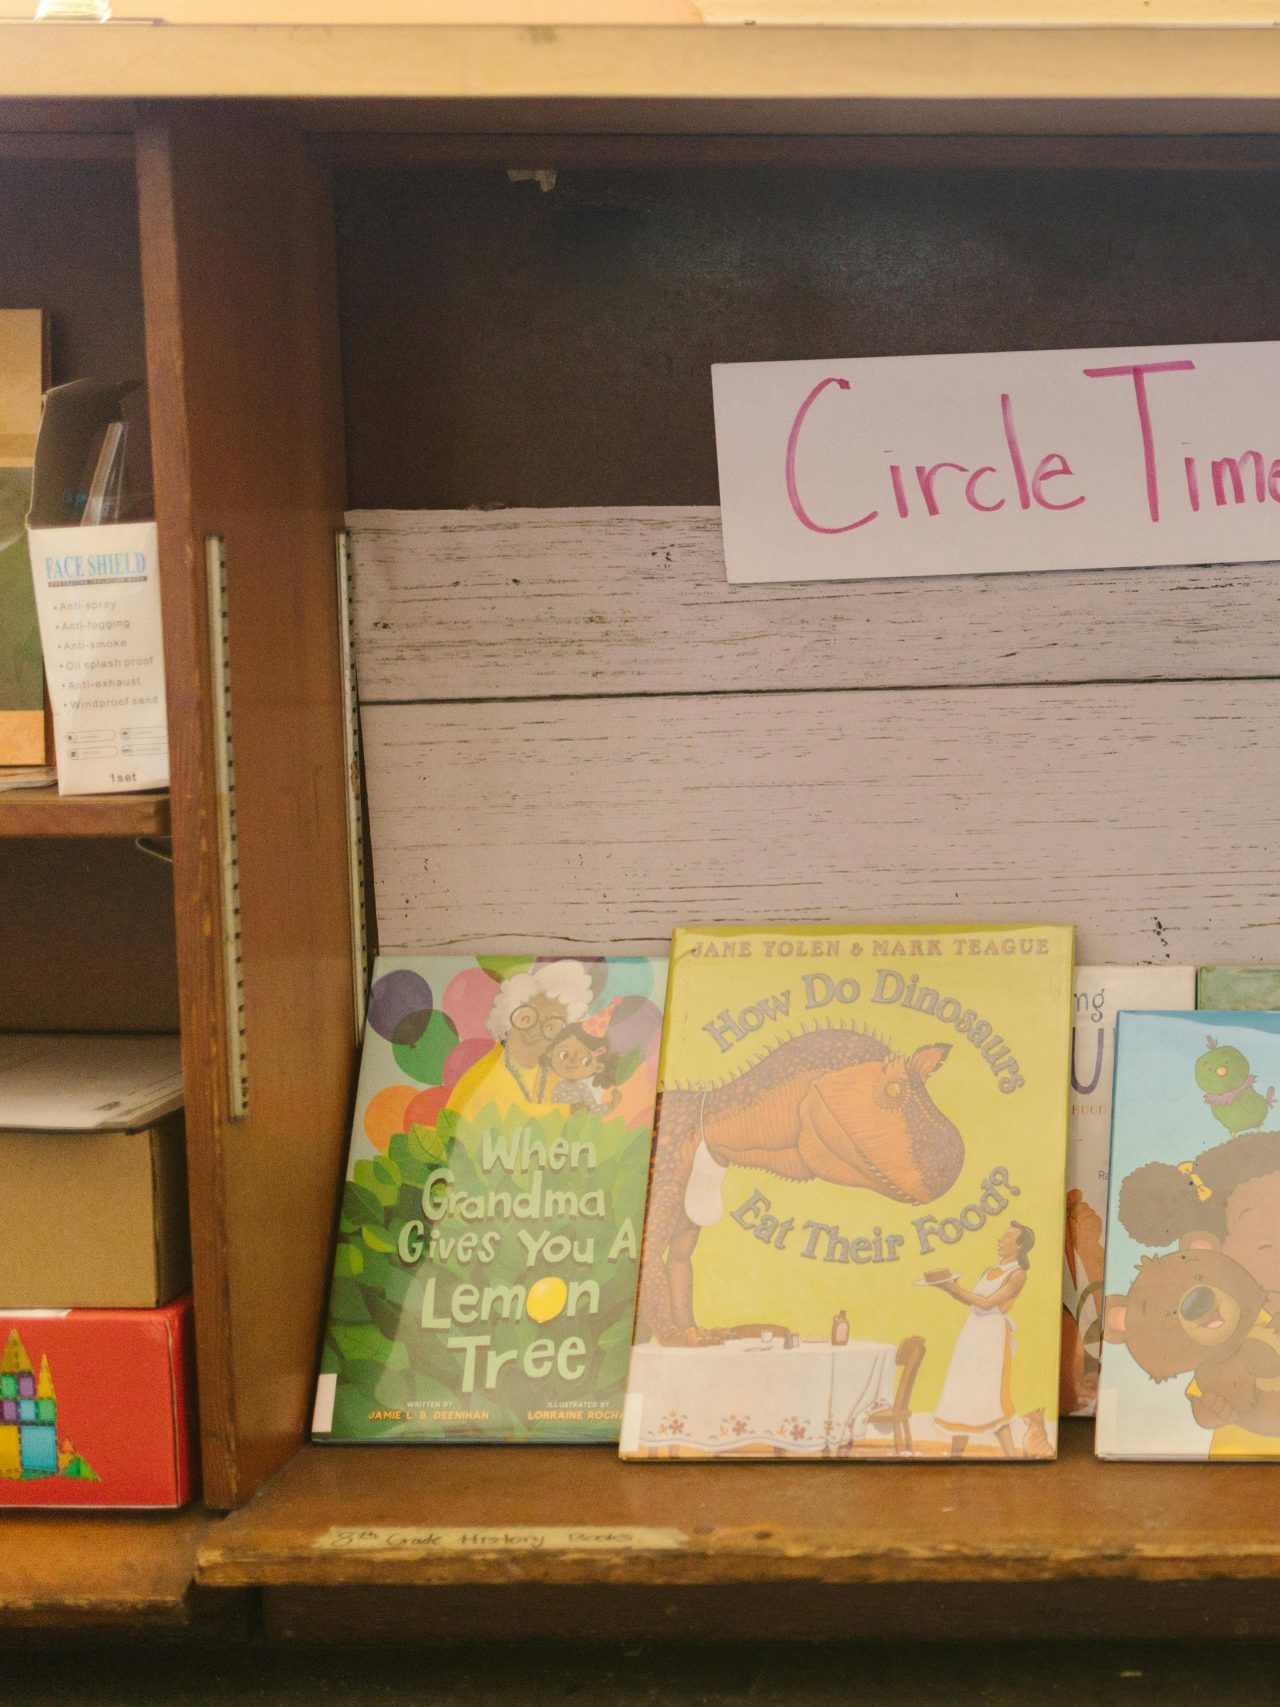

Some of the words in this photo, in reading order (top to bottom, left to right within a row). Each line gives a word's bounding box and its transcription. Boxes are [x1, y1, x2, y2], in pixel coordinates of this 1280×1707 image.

[785, 378, 1085, 534] Circle
[45, 556, 85, 579] FACE
[87, 552, 147, 577] SHIELD
[62, 620, 131, 632] Anti-fogging
[64, 641, 127, 651] Anti-smoke
[83, 659, 123, 670] splash
[124, 656, 154, 668] proof
[68, 678, 141, 689] Anti-exhaust
[70, 698, 130, 710] Windproof
[692, 941, 752, 957] JANE
[763, 940, 840, 957] YOLEN
[851, 941, 863, 957] &
[871, 939, 942, 956] MARK
[953, 938, 1050, 956] TEAGUE
[702, 990, 791, 1053] How
[801, 972, 861, 1010] Do
[871, 968, 1026, 1095] Dinosaurs
[481, 1127, 597, 1171] When
[422, 1168, 606, 1222] Grandma
[729, 1189, 795, 1249] Eat
[800, 1220, 904, 1264] Their
[911, 1166, 1021, 1255] Food?
[398, 1219, 501, 1264] Gives
[518, 1229, 594, 1266] You
[607, 1217, 637, 1260] A
[421, 1277, 600, 1329] Lemon
[447, 1335, 587, 1393] Tree
[407, 1401, 440, 1409] WRITTEN
[369, 1411, 401, 1420] JAMIE
[434, 1411, 489, 1420] DEENIHAN
[528, 1411, 582, 1420] LORRAINE
[386, 1533, 443, 1546] Grade
[457, 1533, 545, 1548] History
[568, 1533, 633, 1543] Books
